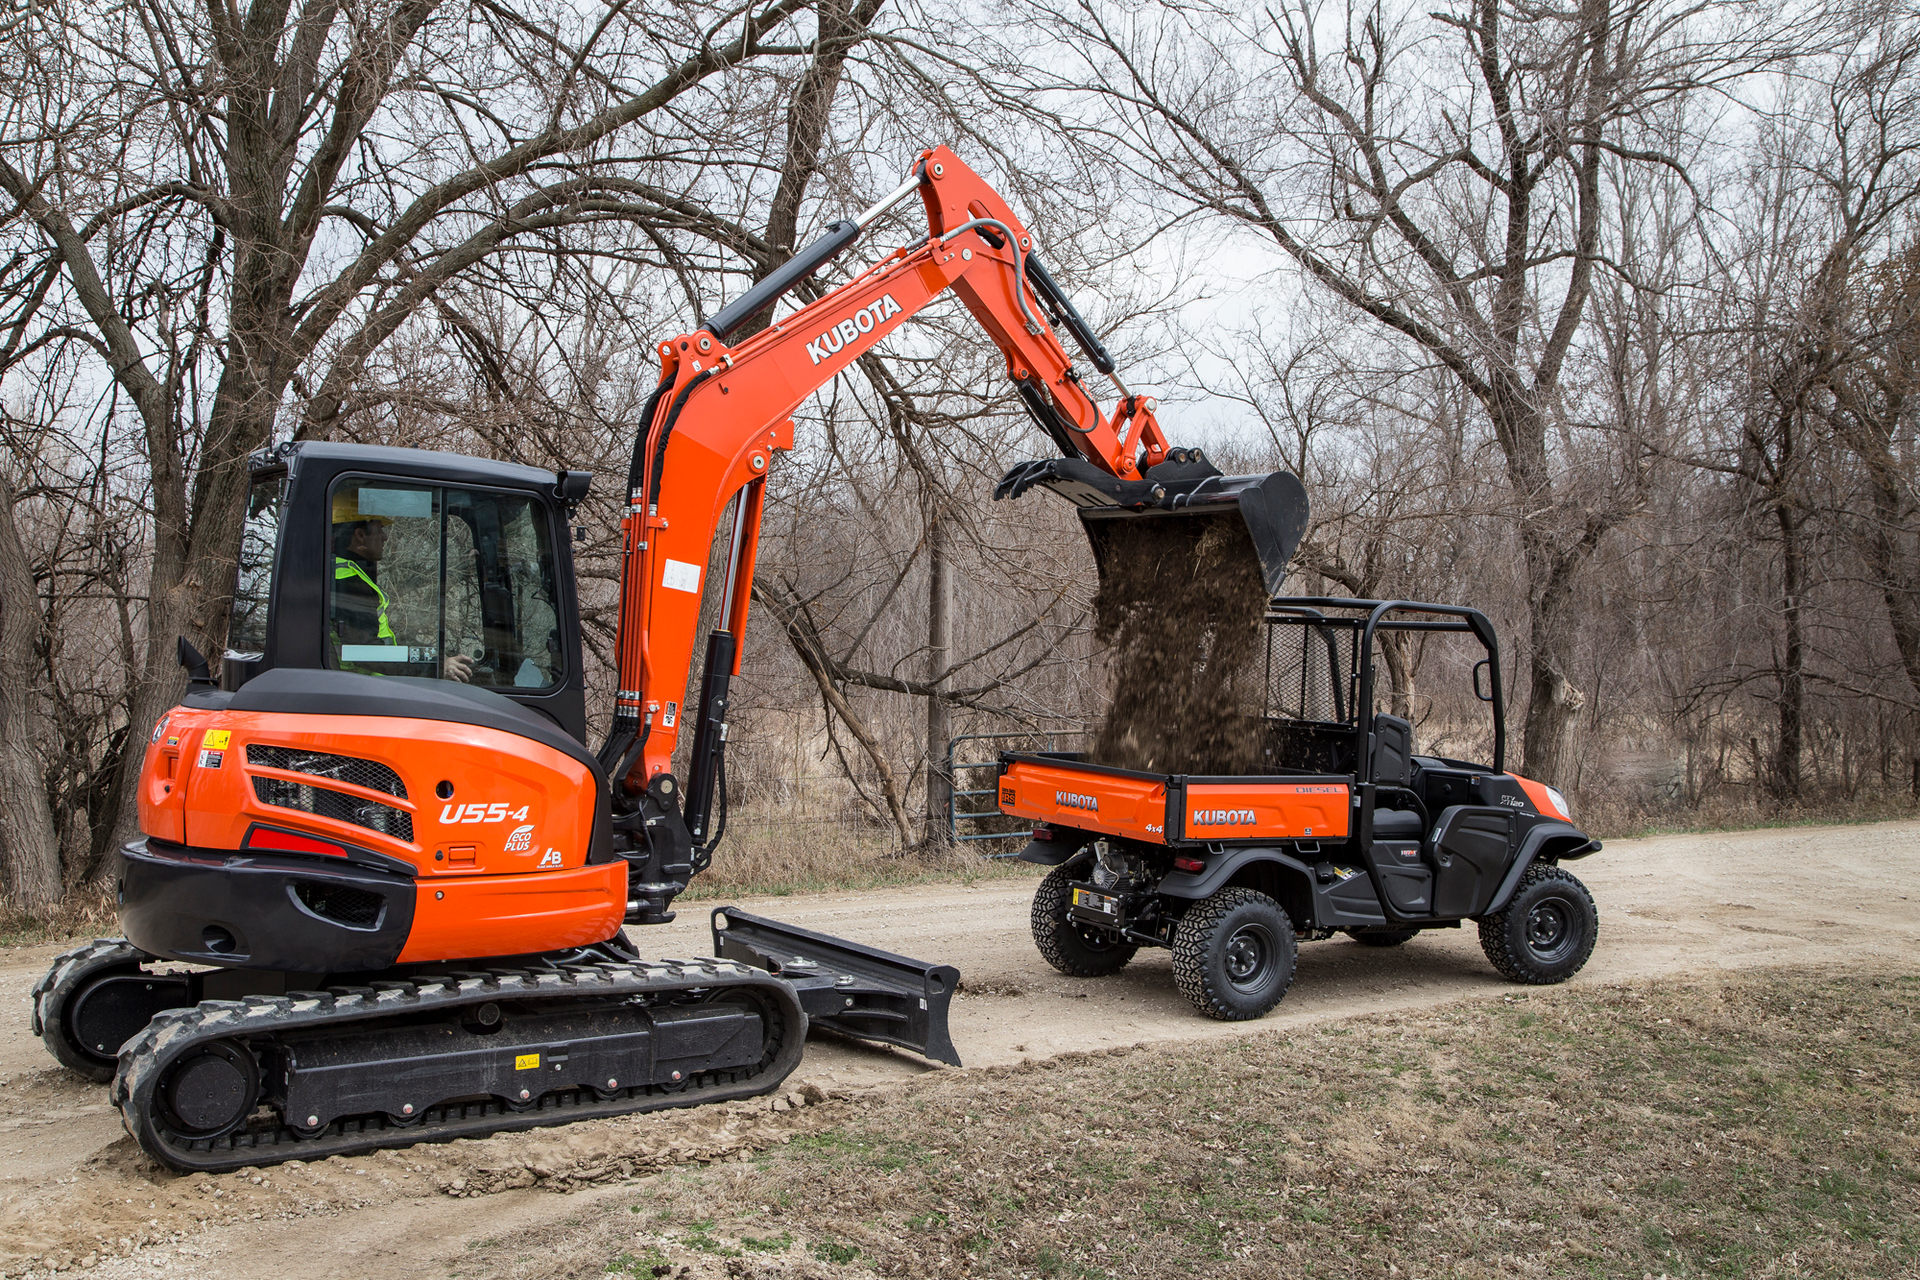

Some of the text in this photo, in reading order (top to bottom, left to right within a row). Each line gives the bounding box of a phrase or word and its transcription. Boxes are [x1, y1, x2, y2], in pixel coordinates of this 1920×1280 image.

[805, 293, 903, 366] KUBOTA
[1295, 786, 1343, 794] DIESEL
[1055, 790, 1099, 812] KUBOTA
[439, 803, 530, 824] U55-4
[1193, 809, 1257, 826] KUBOTA
[1145, 823, 1163, 834] 4x4
[512, 832, 532, 842] eco
[503, 841, 530, 852] PLUS
